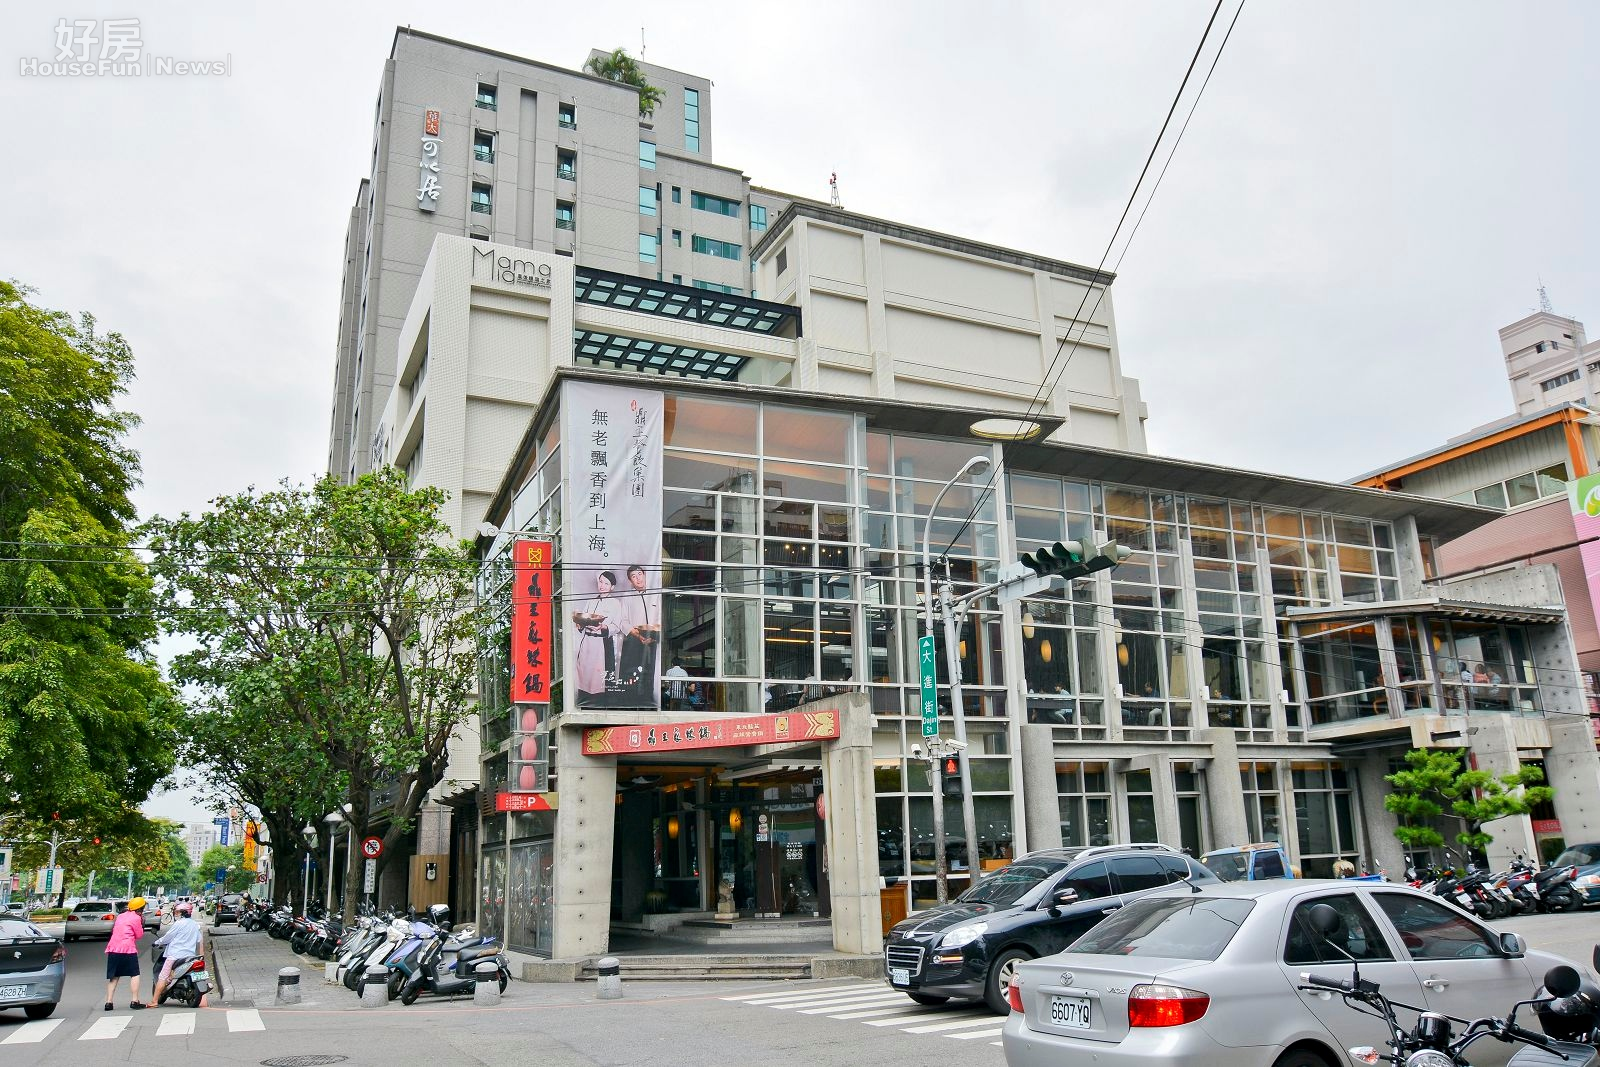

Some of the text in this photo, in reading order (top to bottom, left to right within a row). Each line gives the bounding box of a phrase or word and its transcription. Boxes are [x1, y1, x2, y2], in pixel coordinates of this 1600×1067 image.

[922, 649, 934, 715] 大進街
[527, 797, 536, 807] P
